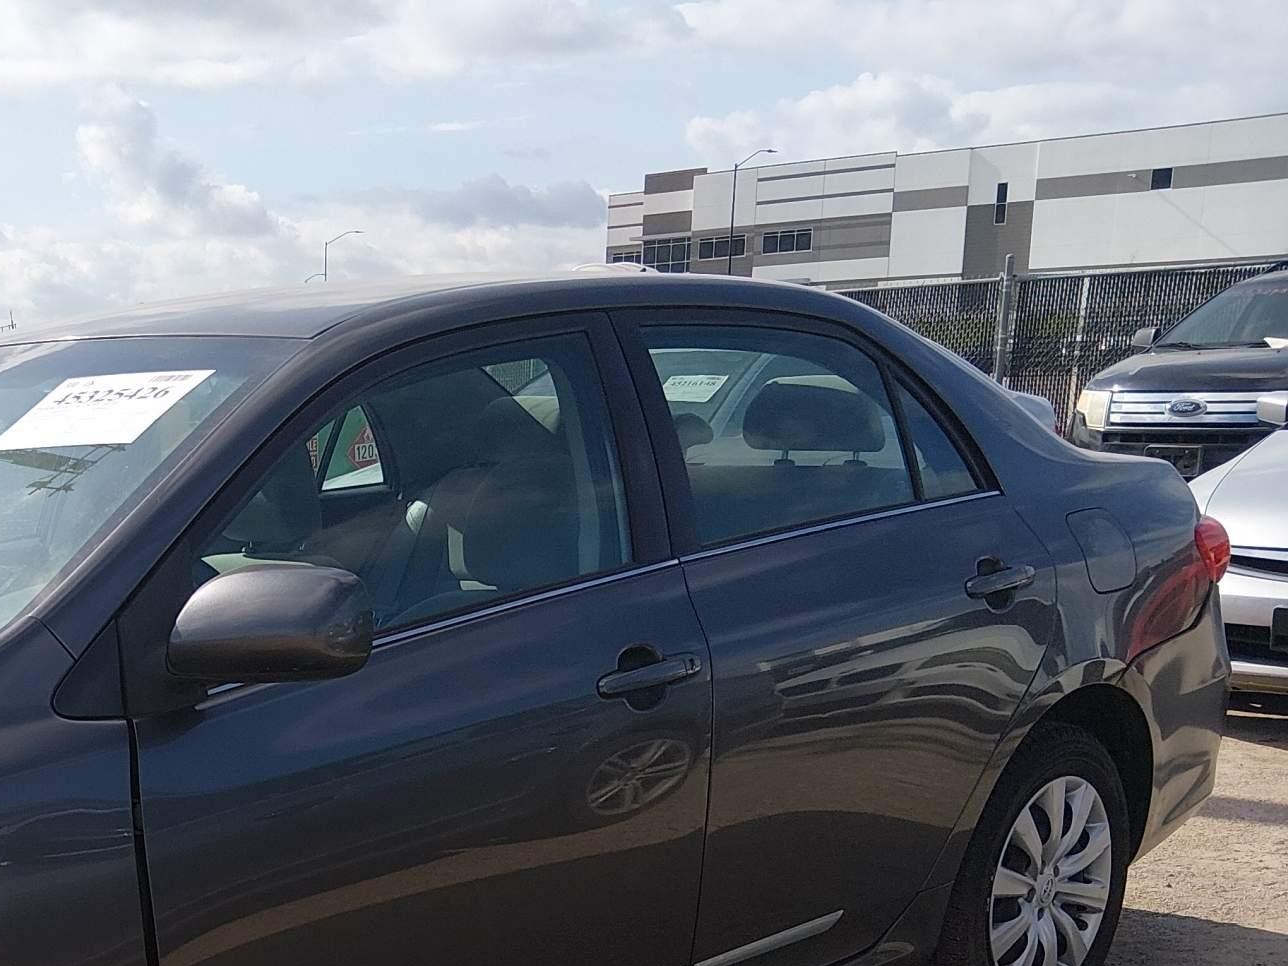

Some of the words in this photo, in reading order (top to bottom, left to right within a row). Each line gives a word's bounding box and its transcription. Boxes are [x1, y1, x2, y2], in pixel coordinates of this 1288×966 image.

[53, 386, 173, 405] 45325426
[1173, 402, 1195, 411] Ford
[356, 444, 377, 460] 120
